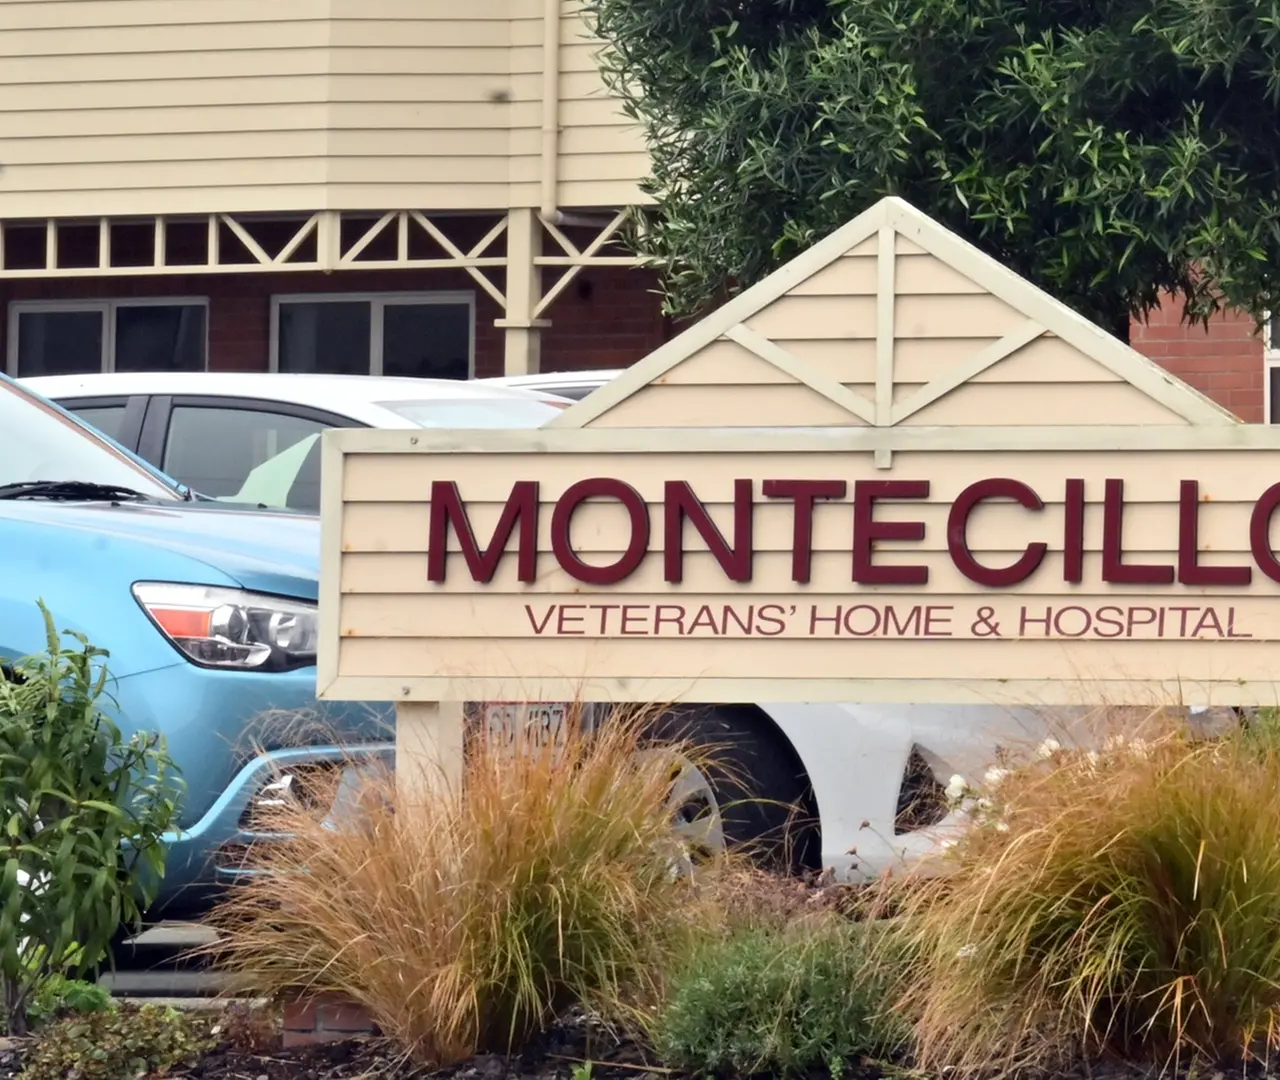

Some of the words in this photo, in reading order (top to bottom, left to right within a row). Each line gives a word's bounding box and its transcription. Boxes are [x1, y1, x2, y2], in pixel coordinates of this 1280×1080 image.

[525, 603, 797, 637] VETERANS'
[808, 605, 953, 637] HOME
[970, 605, 1002, 638] &
[1018, 605, 1253, 639] HOSPITAL
